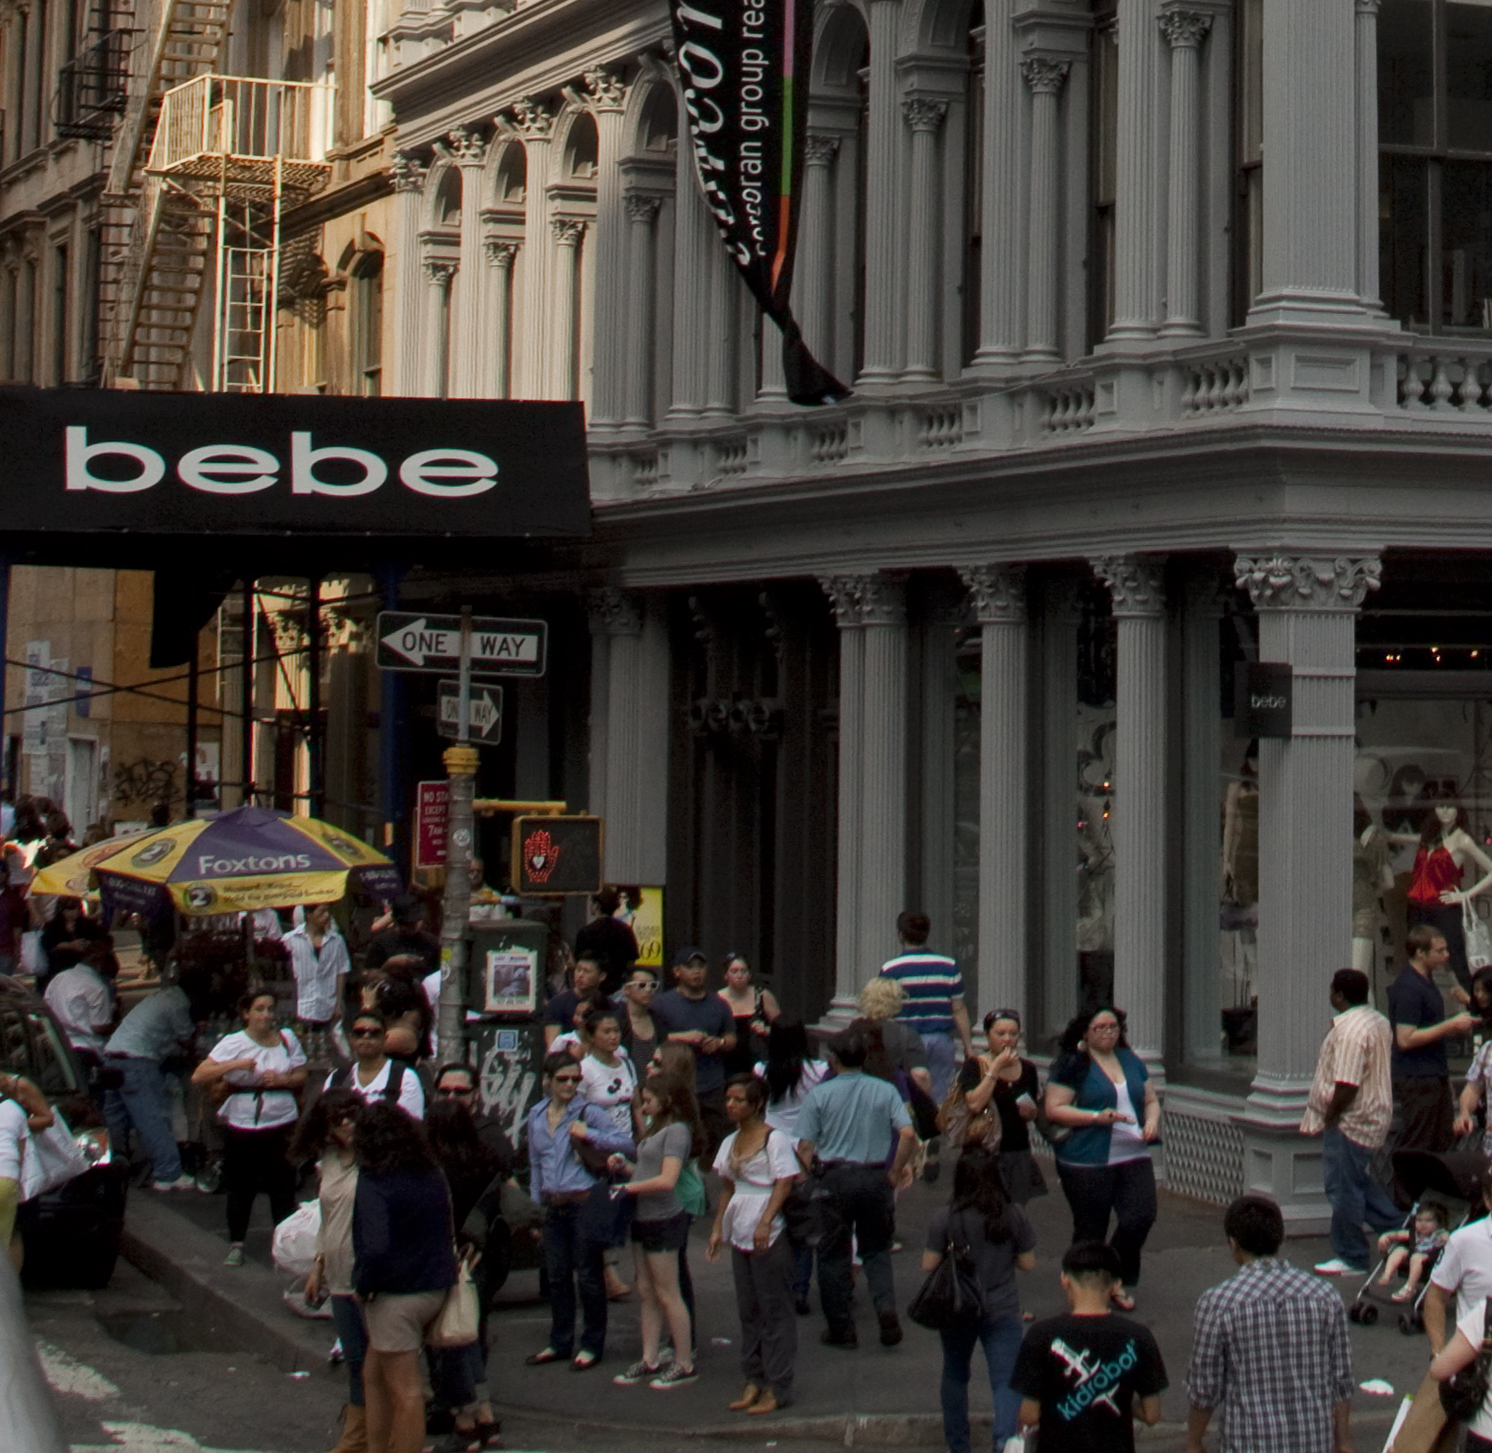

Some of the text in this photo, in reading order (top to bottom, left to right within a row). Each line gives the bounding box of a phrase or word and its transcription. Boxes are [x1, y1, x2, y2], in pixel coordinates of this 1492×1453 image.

[739, 49, 770, 129] group
[65, 425, 500, 498] bebe
[402, 631, 526, 657] ONE WAY
[445, 698, 494, 724] ON WAY
[1251, 693, 1287, 709] bebe
[198, 853, 312, 875] Foxtons
[190, 889, 207, 907] 2
[1056, 1341, 1138, 1421] kidrobot
